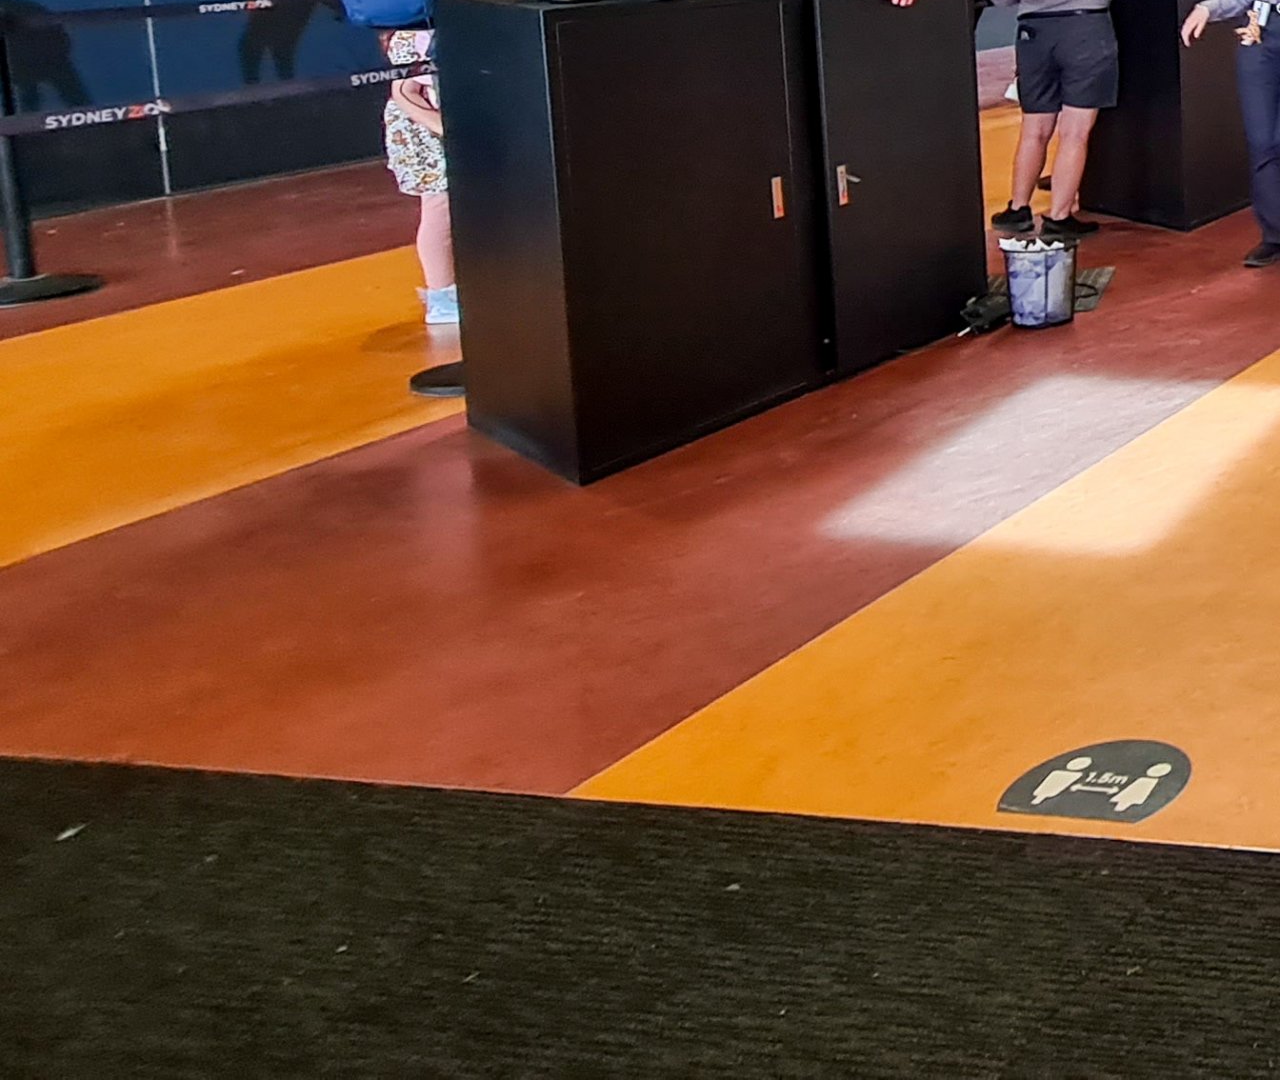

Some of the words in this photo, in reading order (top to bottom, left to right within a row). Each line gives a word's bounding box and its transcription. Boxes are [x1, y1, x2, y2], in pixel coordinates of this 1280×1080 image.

[199, 1, 247, 14] SYDNEY
[350, 68, 409, 87] SYDNEY
[45, 106, 127, 130] SYDNEY
[1085, 771, 1129, 784] 1.5m
